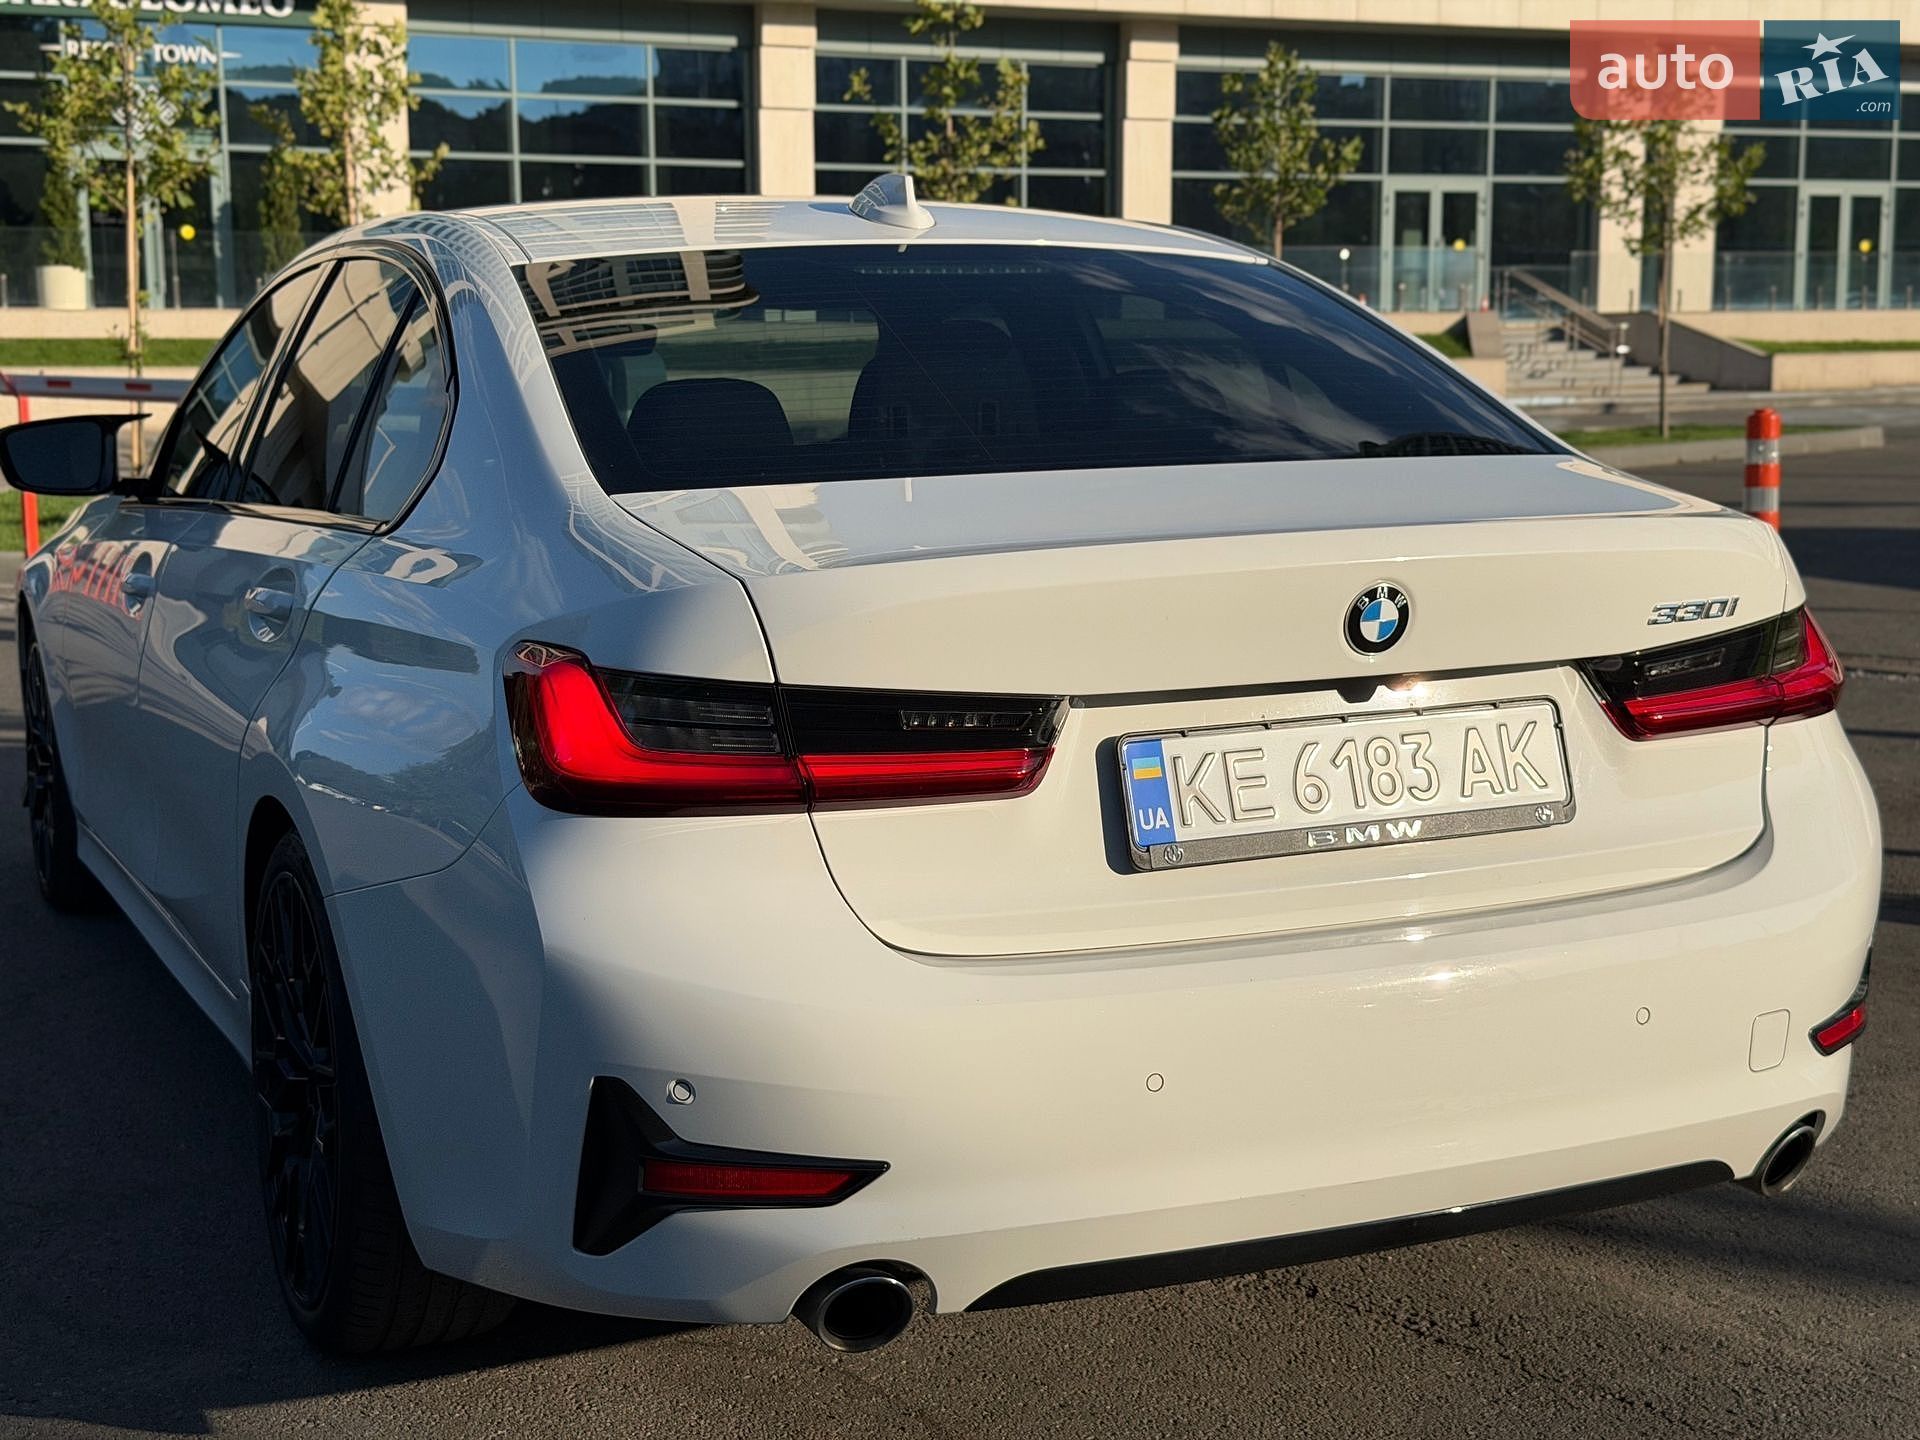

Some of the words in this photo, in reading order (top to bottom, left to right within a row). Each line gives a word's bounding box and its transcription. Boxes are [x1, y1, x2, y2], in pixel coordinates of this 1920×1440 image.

[153, 43, 218, 64] TOWN
[1357, 586, 1407, 611] BMW
[1171, 748, 1276, 826] KE
[1292, 732, 1440, 815] 6183
[1460, 720, 1549, 798] AK
[1138, 807, 1171, 830] UA
[1307, 819, 1422, 848] BMW
